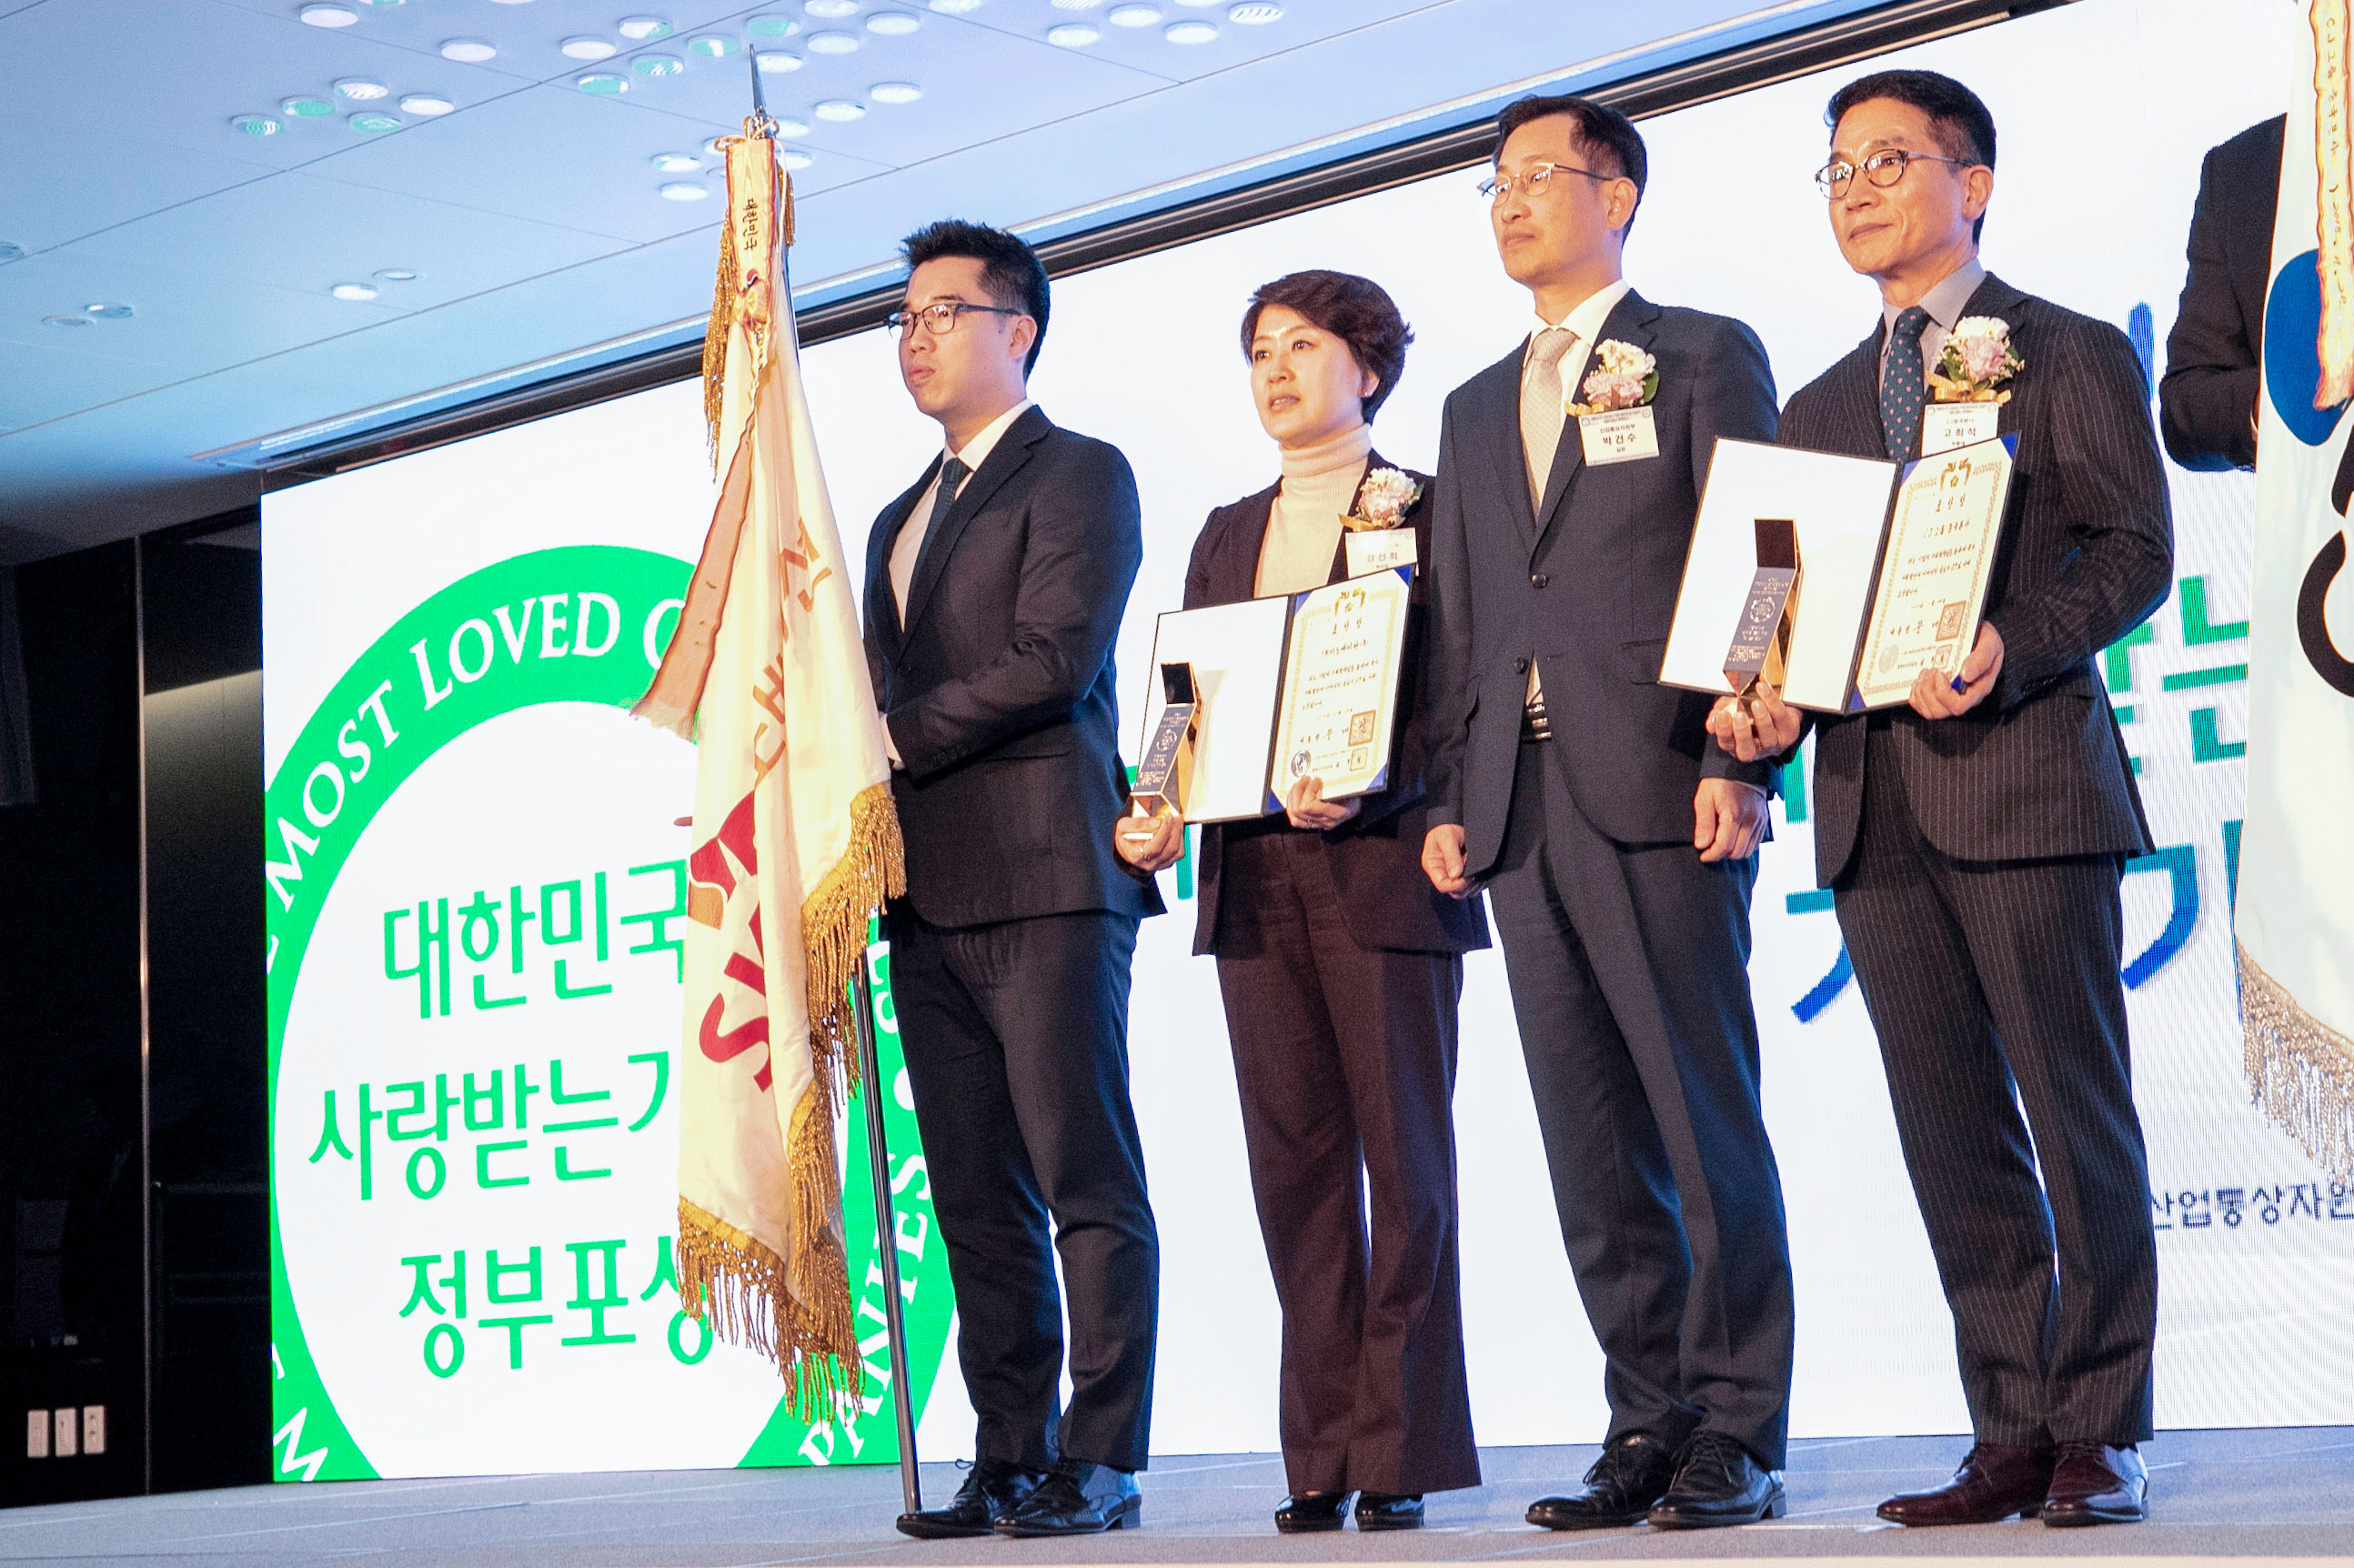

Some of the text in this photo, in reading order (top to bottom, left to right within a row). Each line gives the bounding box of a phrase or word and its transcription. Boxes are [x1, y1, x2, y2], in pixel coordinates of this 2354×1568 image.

[743, 196, 759, 251] 대한민국
[1603, 433, 1636, 446] 박건수
[266, 680, 399, 905] MOST
[409, 591, 621, 711] LOVED
